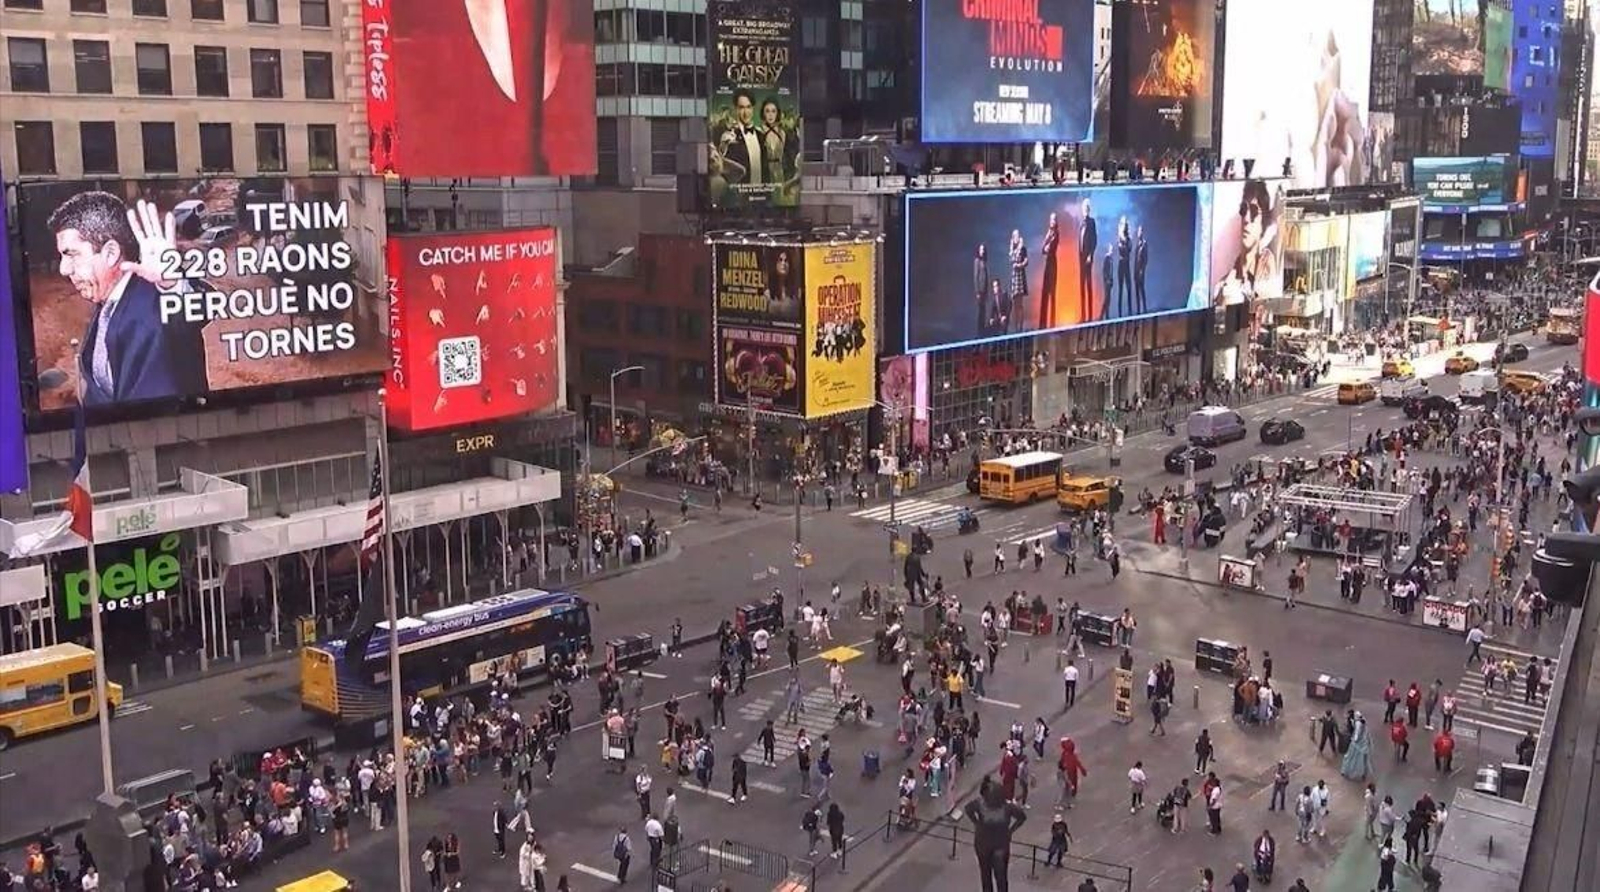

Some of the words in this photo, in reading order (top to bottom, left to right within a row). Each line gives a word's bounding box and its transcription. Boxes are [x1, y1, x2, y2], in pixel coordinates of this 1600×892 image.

[367, 15, 389, 101] Tipless
[718, 44, 743, 64] THE
[745, 45, 789, 65] GREAT
[990, 56, 1063, 72] EVOLUTION
[727, 64, 784, 84] GATSBY
[973, 101, 1024, 123] STREAMING
[1026, 102, 1044, 124] MAY
[246, 201, 349, 232] TENIM
[160, 249, 228, 280] 228
[236, 241, 352, 277] RAONS
[419, 245, 476, 266] CATCH
[480, 244, 503, 262] ME
[505, 243, 518, 259] IF
[519, 240, 541, 258] YOU
[728, 251, 758, 269] IDINA
[722, 268, 765, 288] MENZEL
[159, 280, 299, 324] PERQUÈ
[306, 283, 354, 312] NO
[720, 292, 767, 312] REDWOOD
[220, 323, 356, 362] TORNES
[456, 434, 494, 452] EXPR
[64, 533, 181, 621] pelé
[418, 616, 473, 635] clean-energy
[473, 611, 490, 622] bus
